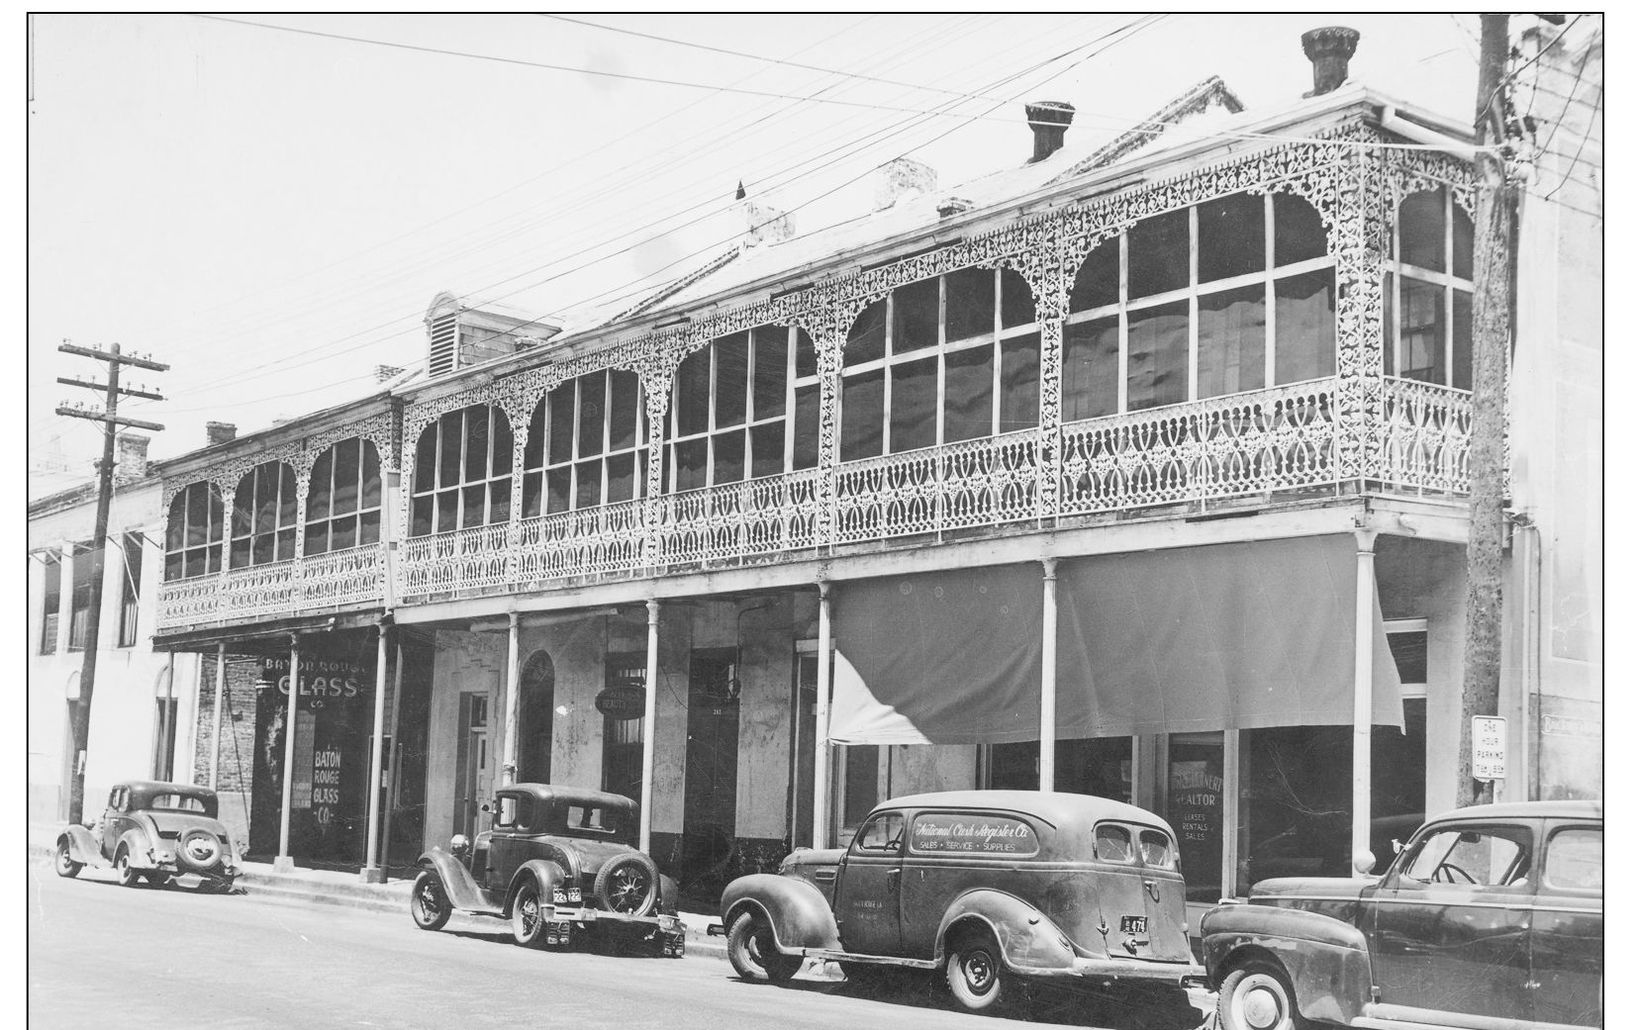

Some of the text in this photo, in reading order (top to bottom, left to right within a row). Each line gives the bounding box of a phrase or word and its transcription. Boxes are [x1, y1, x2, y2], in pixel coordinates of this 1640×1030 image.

[278, 674, 358, 697] GLASS
[315, 751, 341, 767] BATON
[1477, 750, 1504, 760] PARKING
[314, 770, 340, 784] ROUGE
[313, 788, 339, 803] GLASS
[915, 823, 952, 836] National
[952, 823, 975, 836] Cash
[975, 823, 1014, 843] Register
[1182, 823, 1208, 832] RENTALS
[920, 841, 1016, 852] SALES SERVICE SUPPLIES
